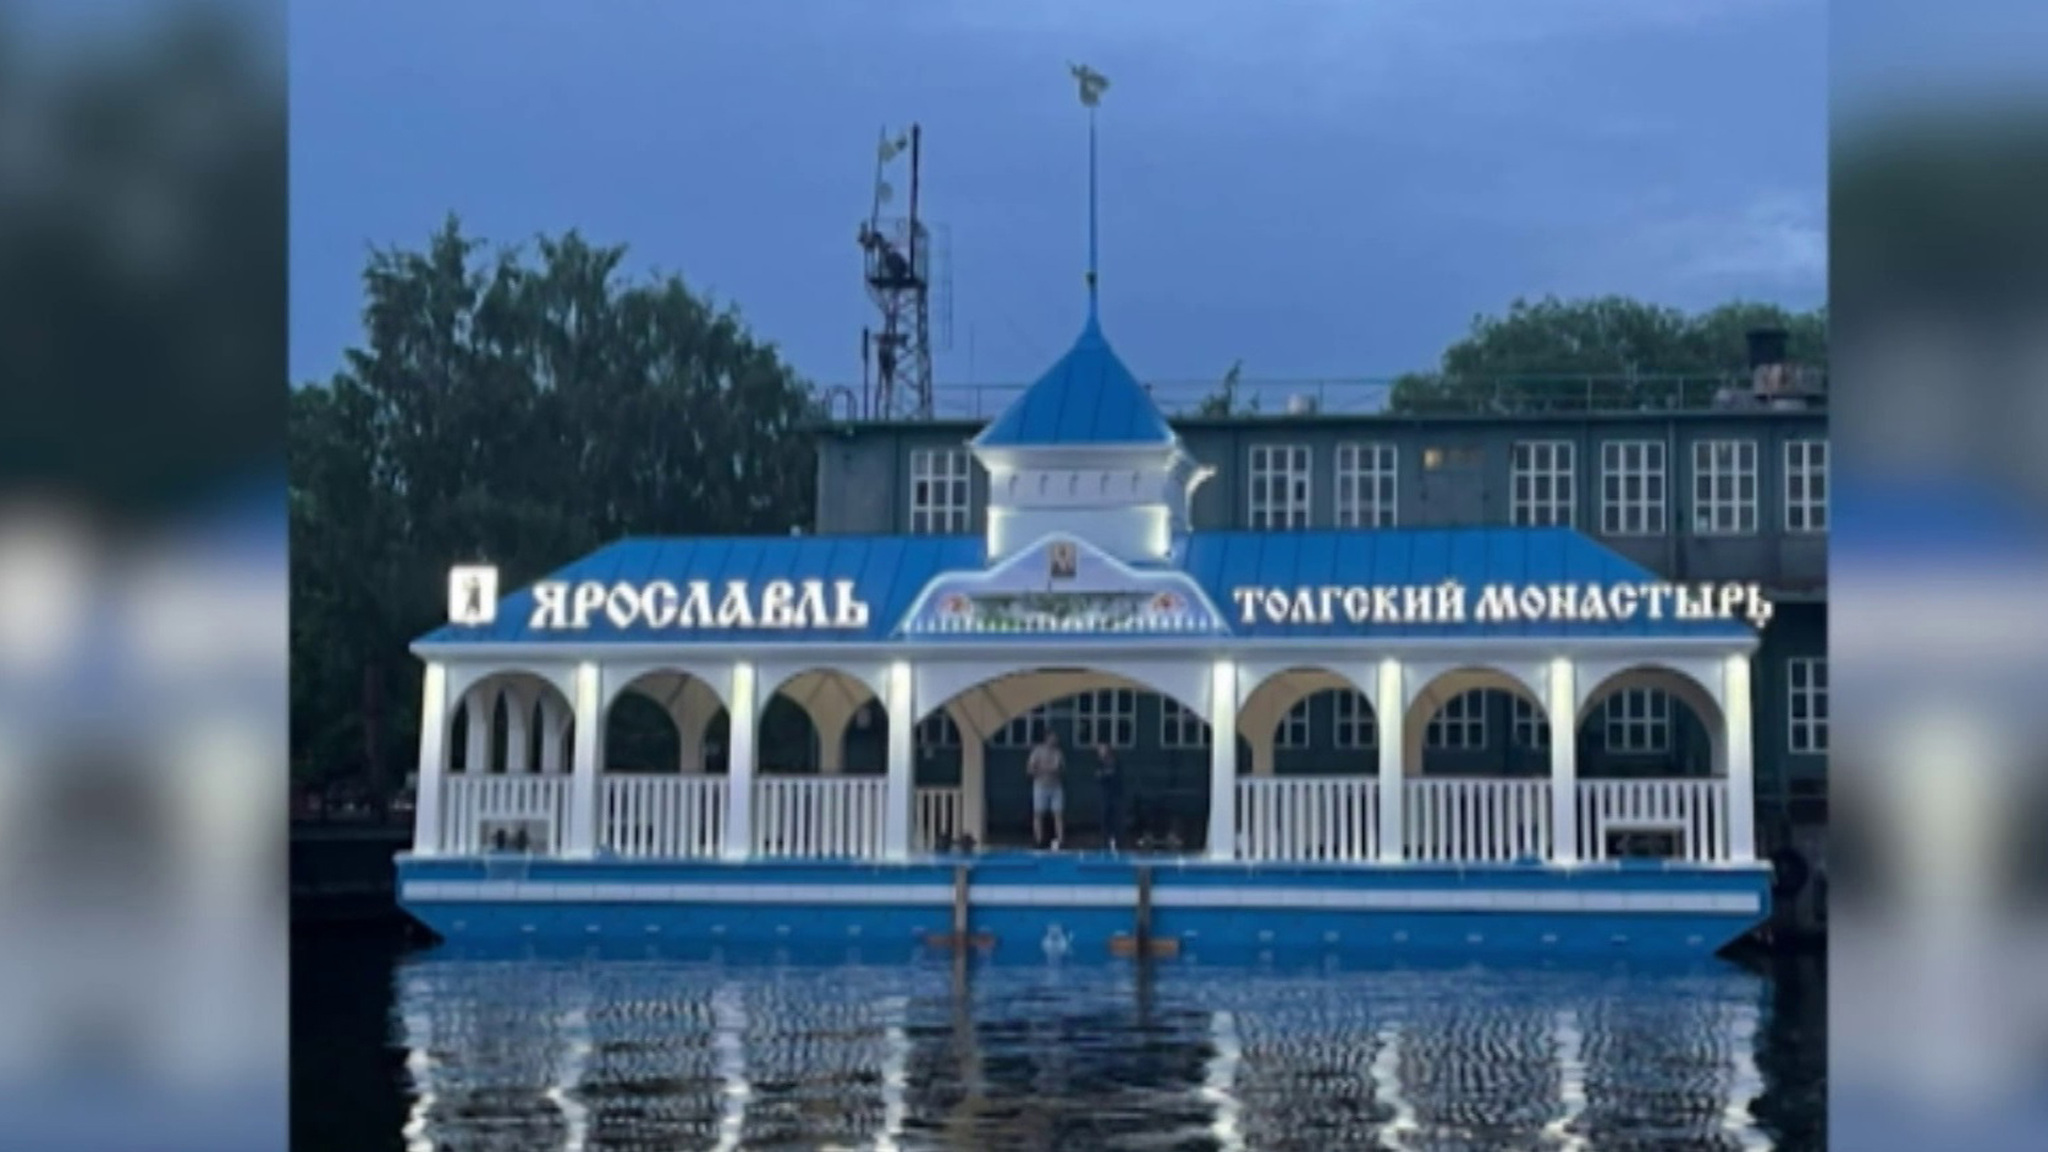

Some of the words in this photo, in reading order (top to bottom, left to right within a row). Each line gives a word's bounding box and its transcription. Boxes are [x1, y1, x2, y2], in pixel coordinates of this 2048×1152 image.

[529, 579, 870, 630] ЯРОСЛАВЛЬ
[1232, 578, 1467, 624] ТОЛГСКИЙ
[1473, 581, 1774, 628] МОНАСТЫРЬ
